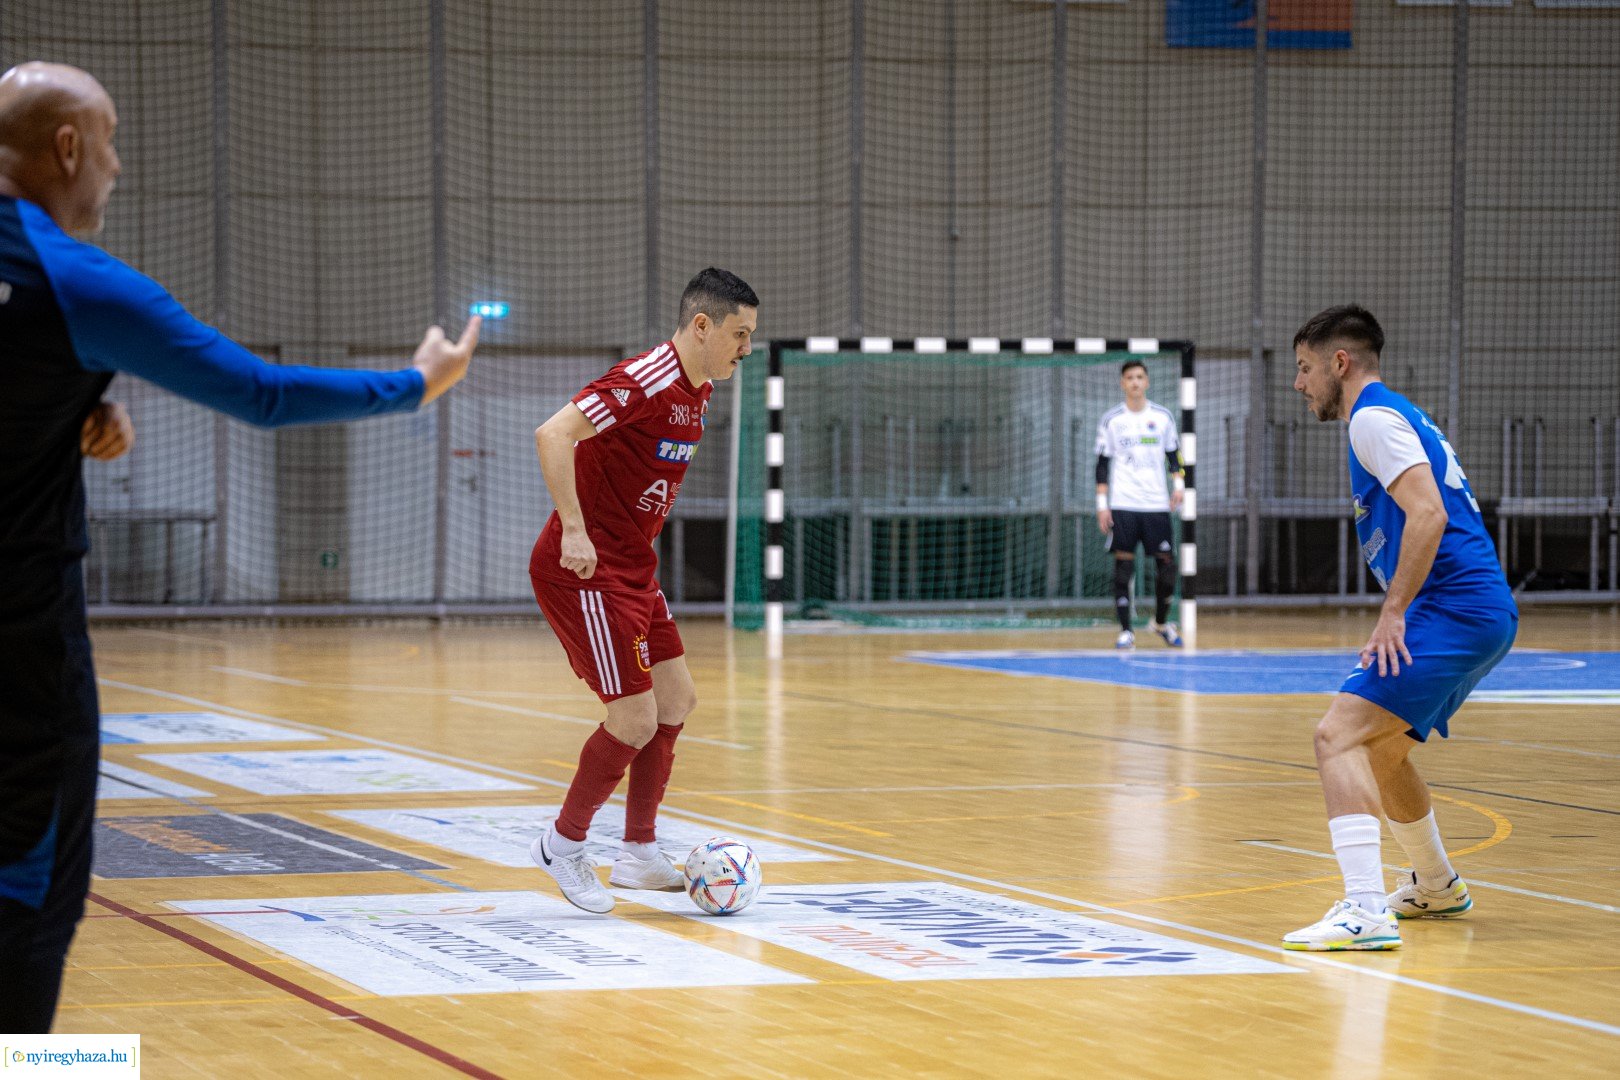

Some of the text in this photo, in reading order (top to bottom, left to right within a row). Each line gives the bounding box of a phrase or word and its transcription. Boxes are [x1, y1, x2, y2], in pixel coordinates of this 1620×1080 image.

[669, 404, 690, 425] 383
[370, 922, 576, 982] SPORTCENTRUM
[466, 920, 646, 966] NYÍREGYHÁZI
